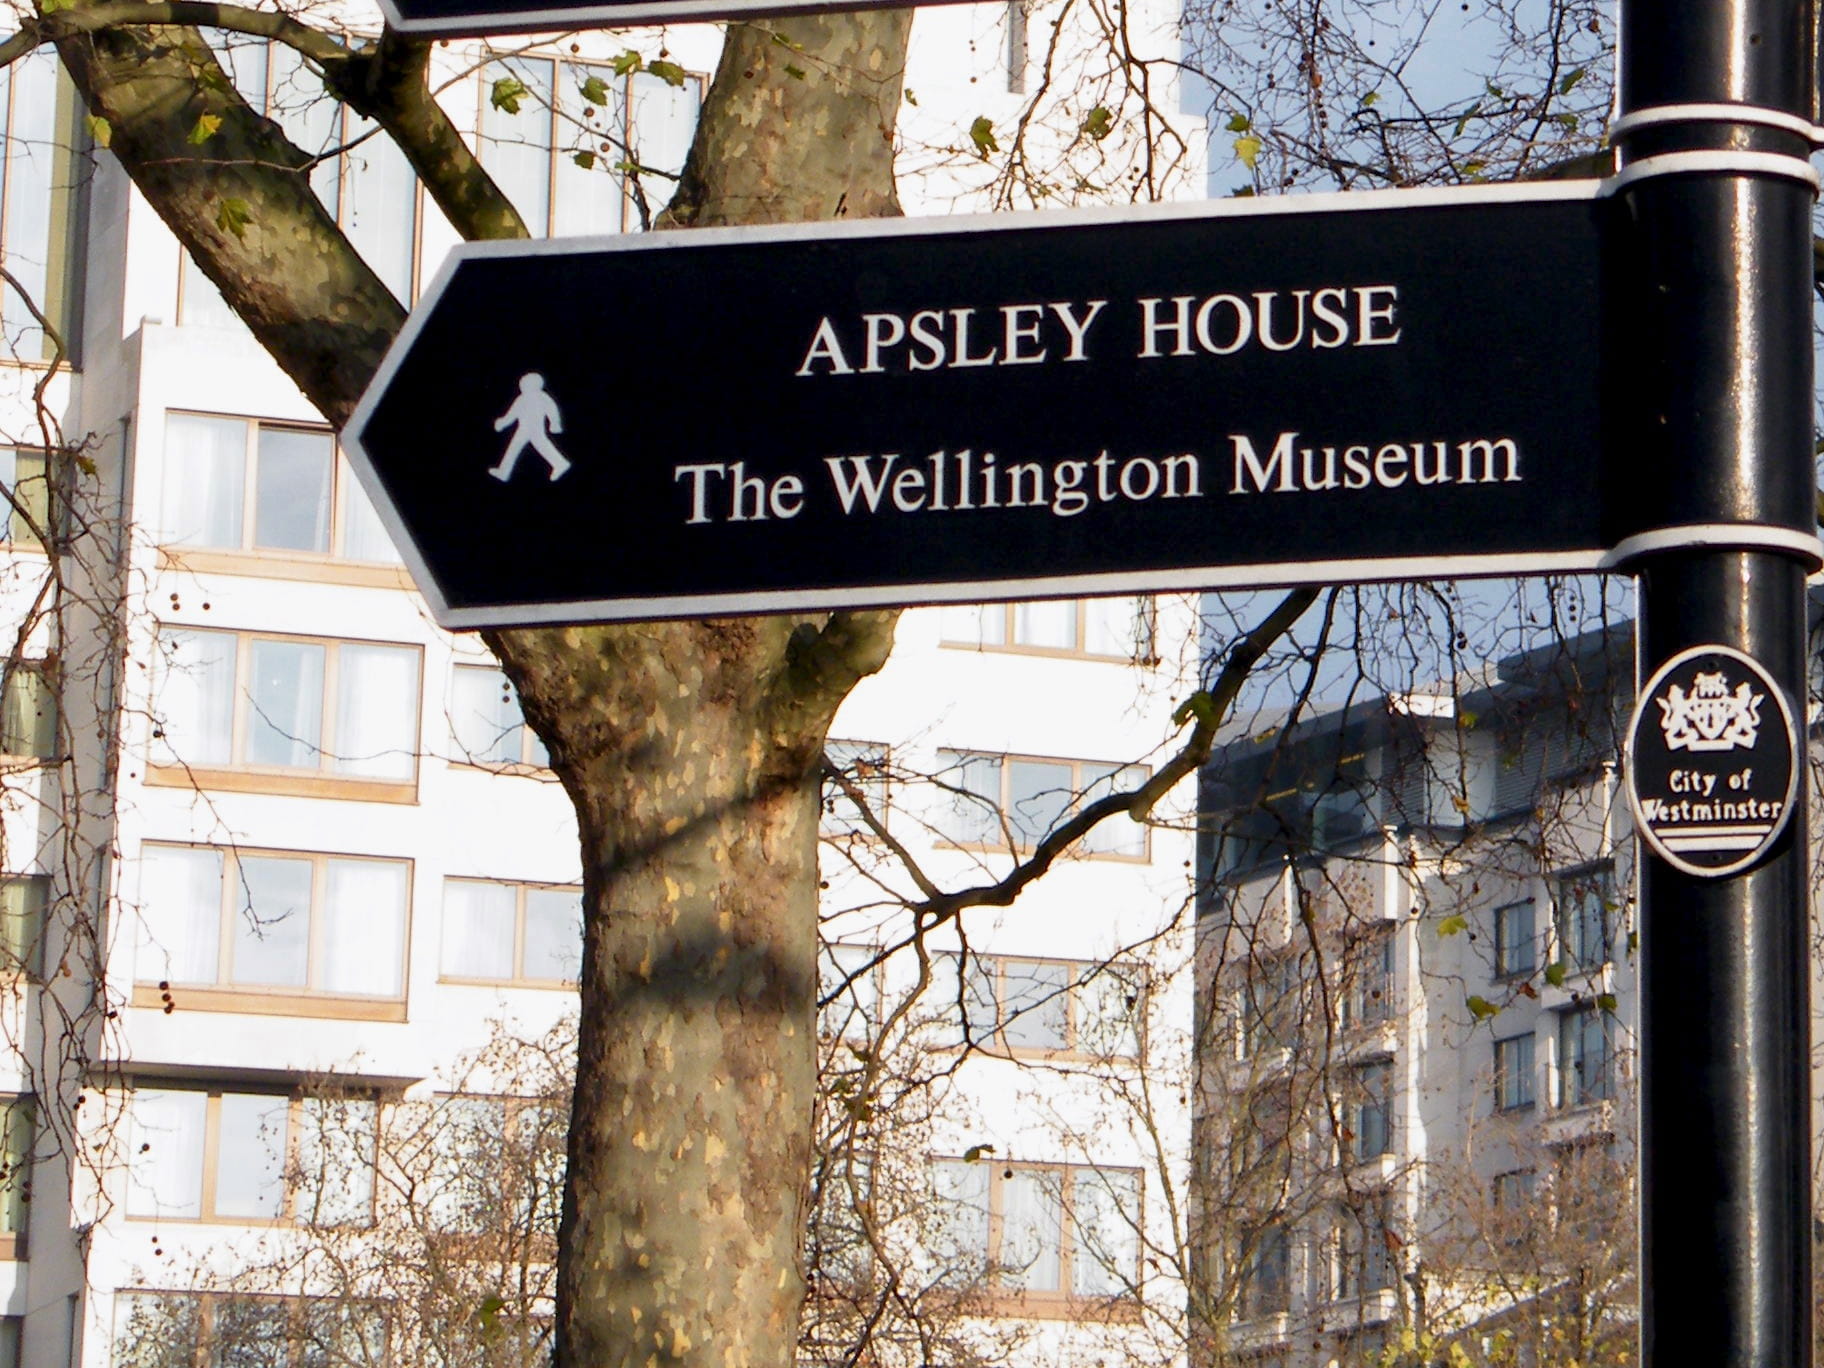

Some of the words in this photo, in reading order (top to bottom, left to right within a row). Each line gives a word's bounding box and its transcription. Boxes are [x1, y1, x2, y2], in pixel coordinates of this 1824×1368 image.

[796, 301, 1107, 376] APSLEY
[1138, 286, 1400, 357] HOUSE
[675, 462, 802, 523] The
[825, 450, 1202, 516] Wellington
[1230, 433, 1521, 493] Museum
[1640, 798, 1782, 822] Westminster
[1669, 769, 1716, 795] City
[1728, 769, 1752, 790] of
